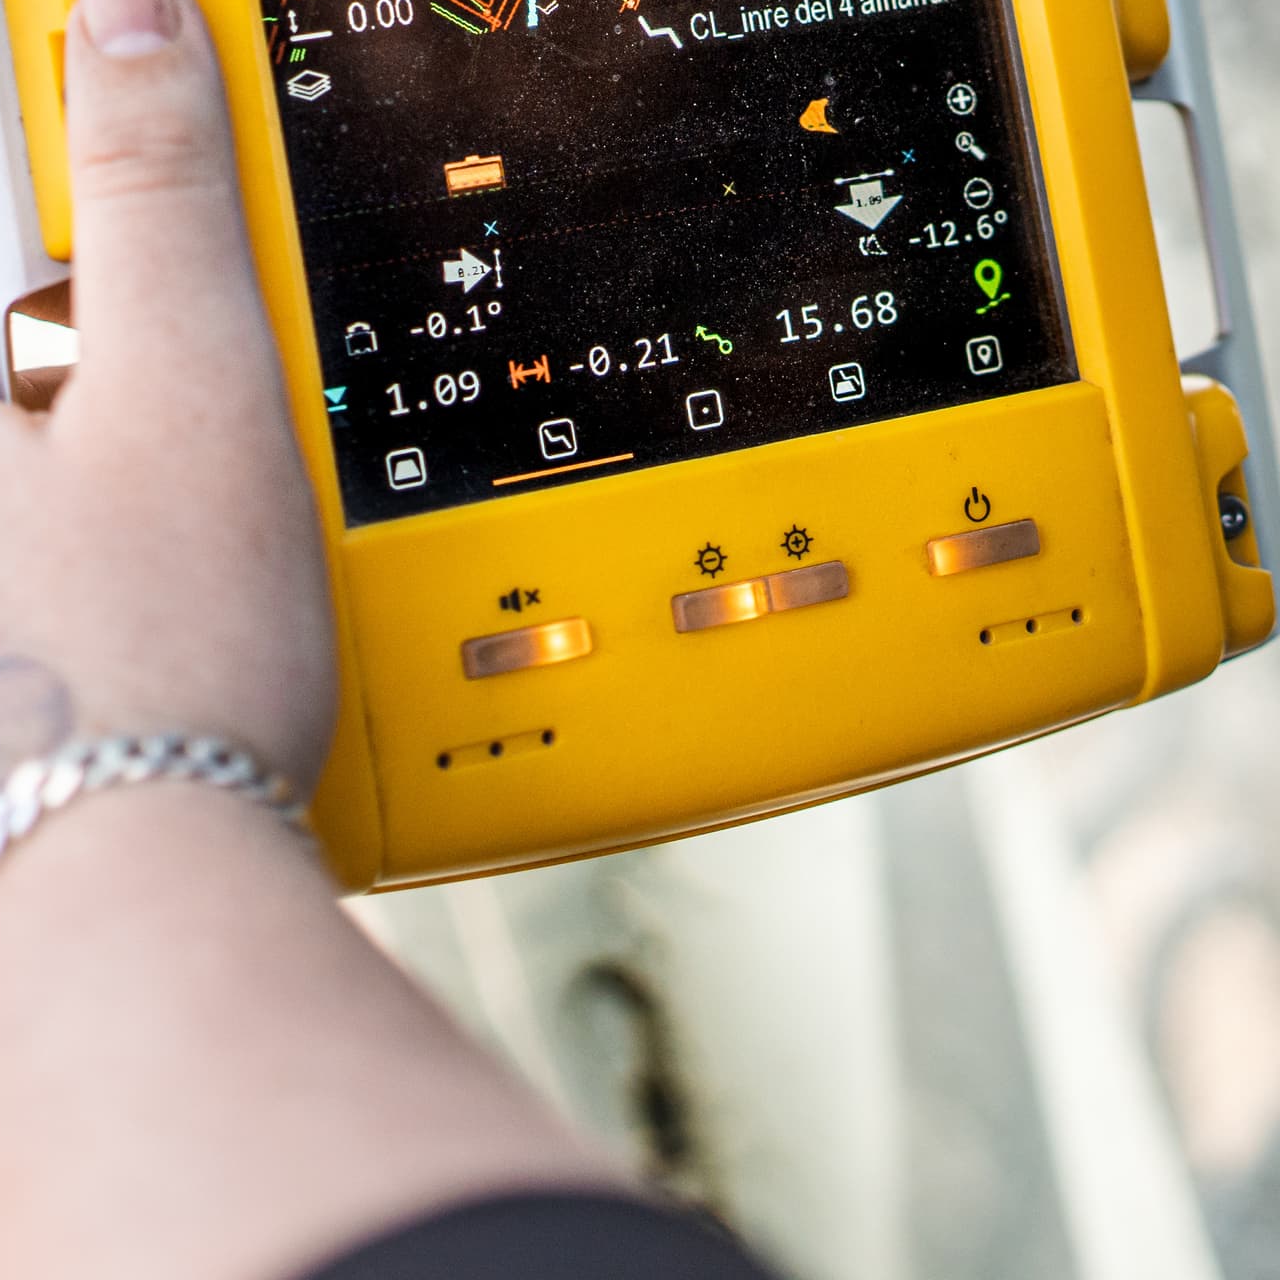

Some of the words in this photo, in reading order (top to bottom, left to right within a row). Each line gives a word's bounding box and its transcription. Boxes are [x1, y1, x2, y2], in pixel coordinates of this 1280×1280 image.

[690, 6, 789, 40] CL_inre
[856, 195, 883, 208] 1.09
[909, 210, 1007, 249] -12.6°
[410, 301, 501, 338] -0.1°
[775, 291, 897, 343] 15.68
[570, 333, 679, 376] -0.21
[385, 370, 480, 416] 1.09
